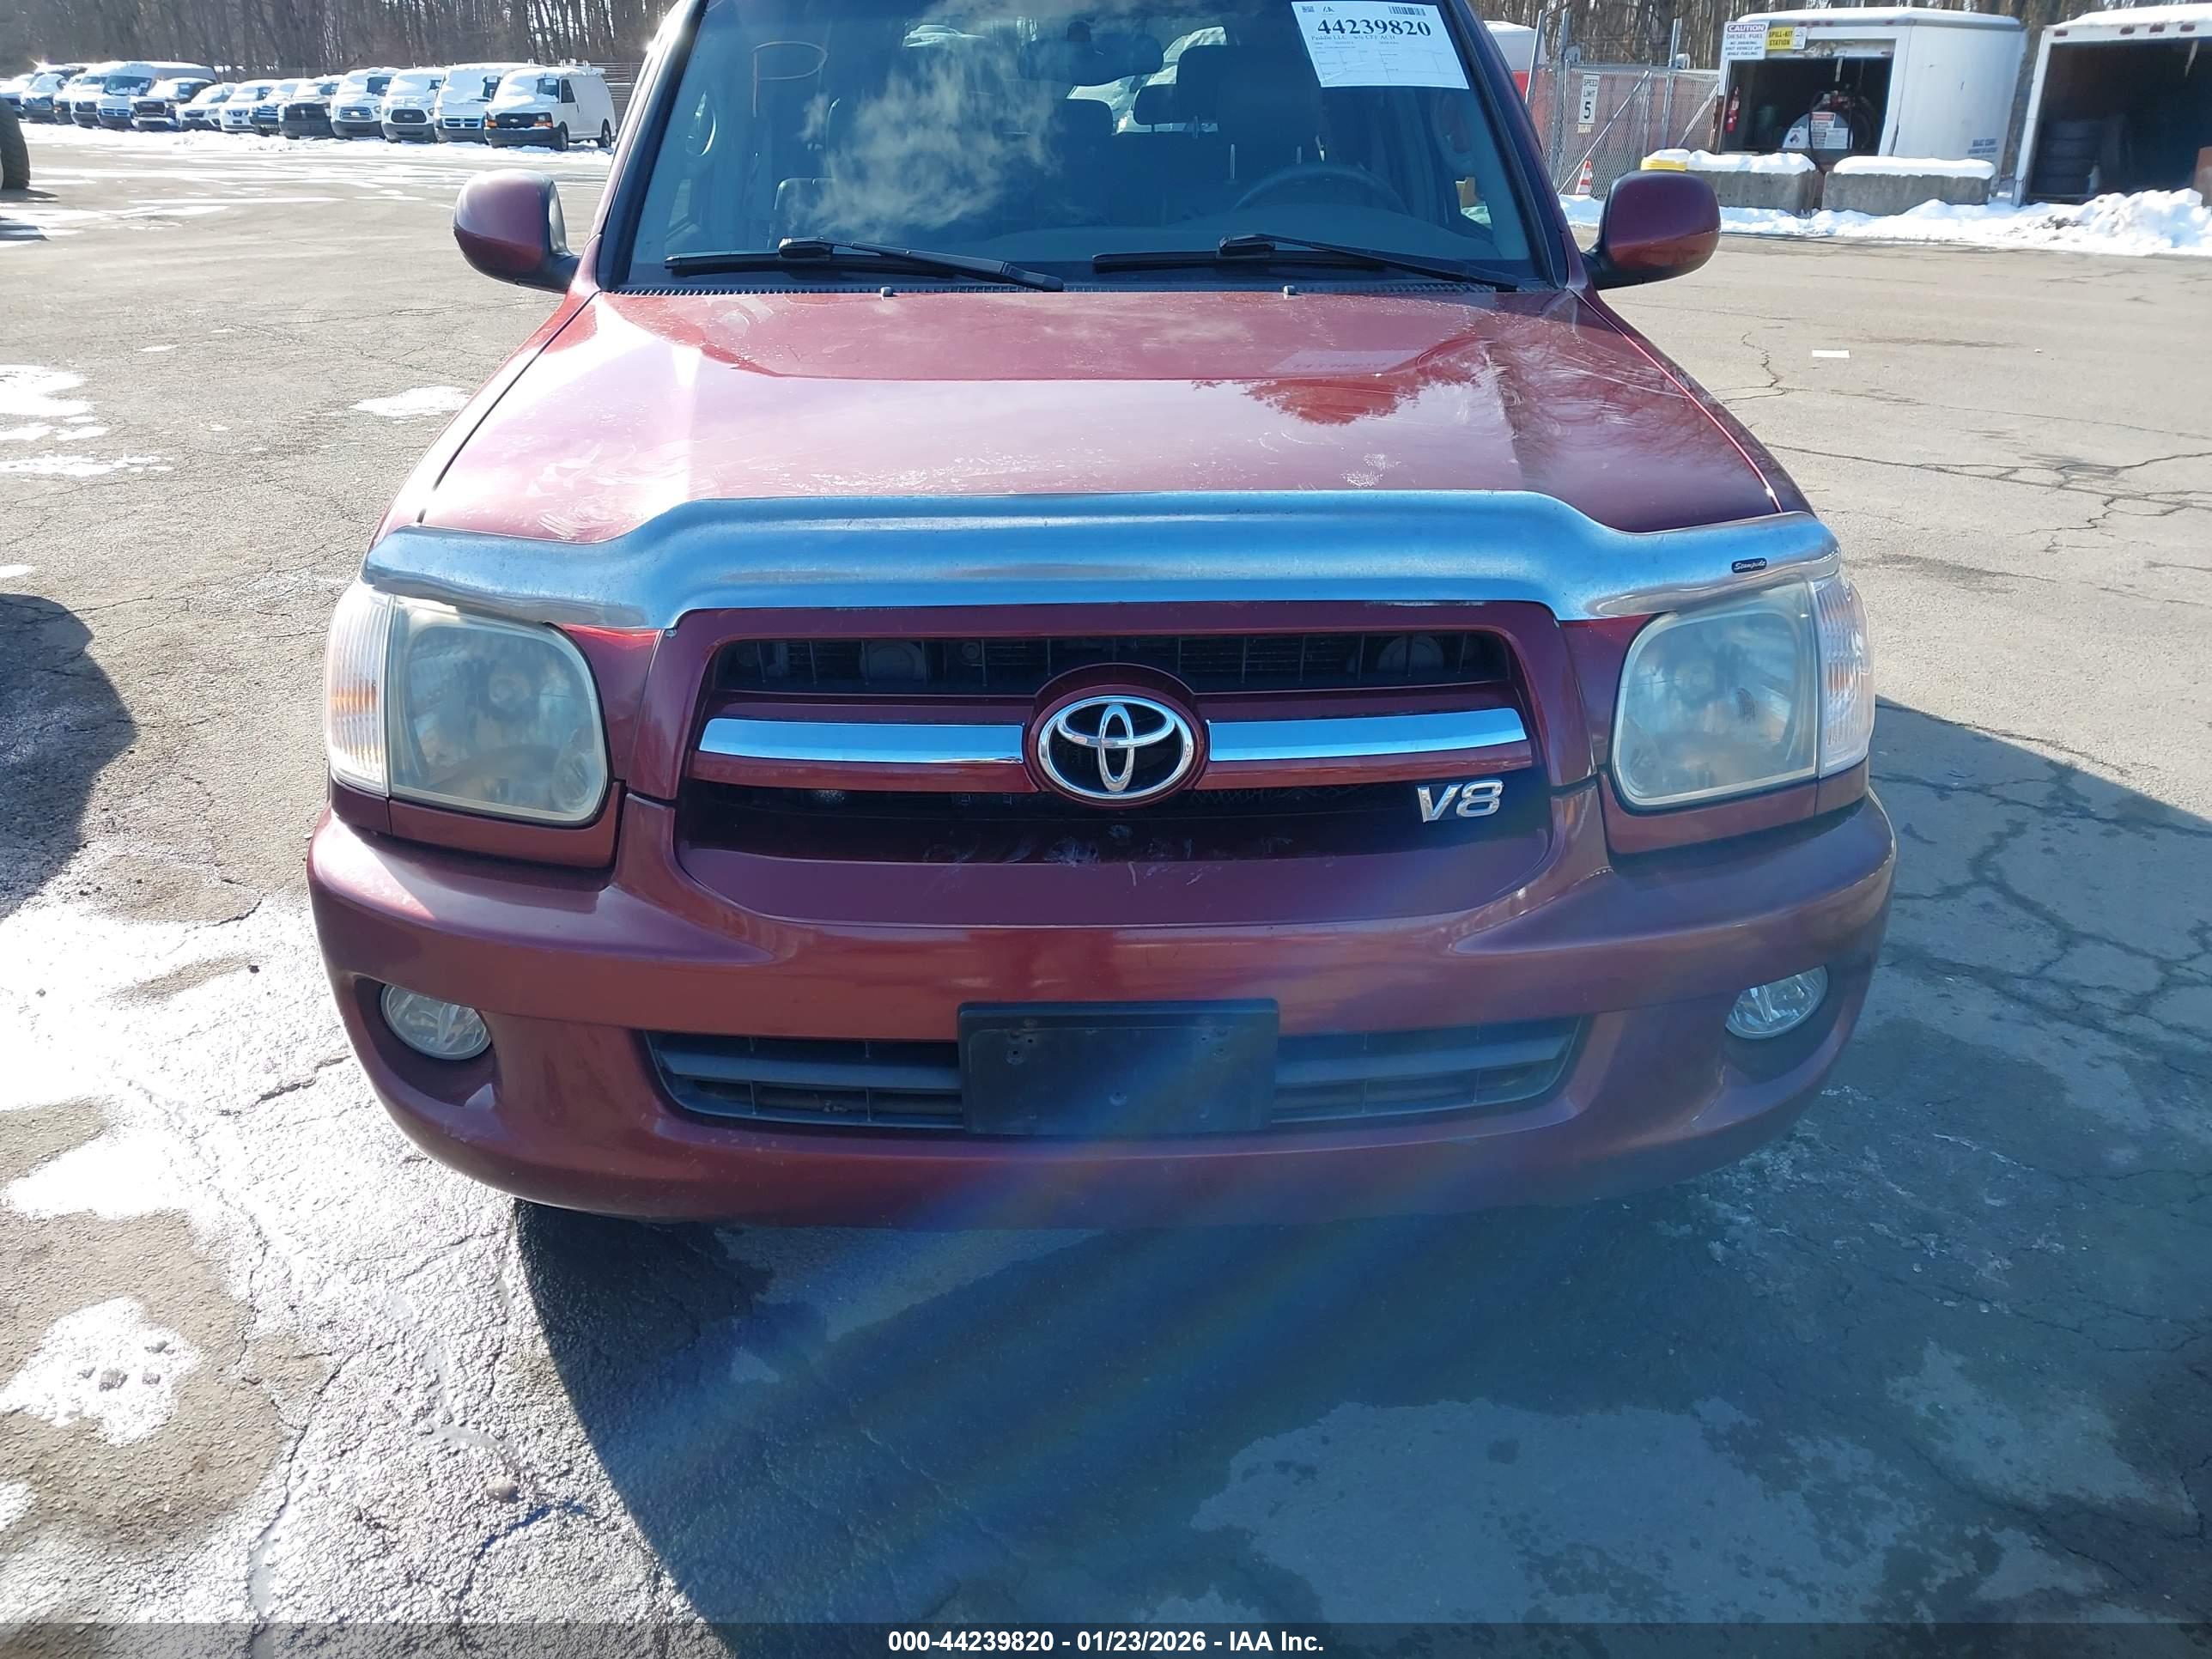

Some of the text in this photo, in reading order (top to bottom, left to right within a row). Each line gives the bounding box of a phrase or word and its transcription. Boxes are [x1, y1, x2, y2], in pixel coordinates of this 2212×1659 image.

[1317, 19, 1431, 36] 44239820
[1583, 101, 1591, 119] 5
[1416, 779, 1504, 823] V8
